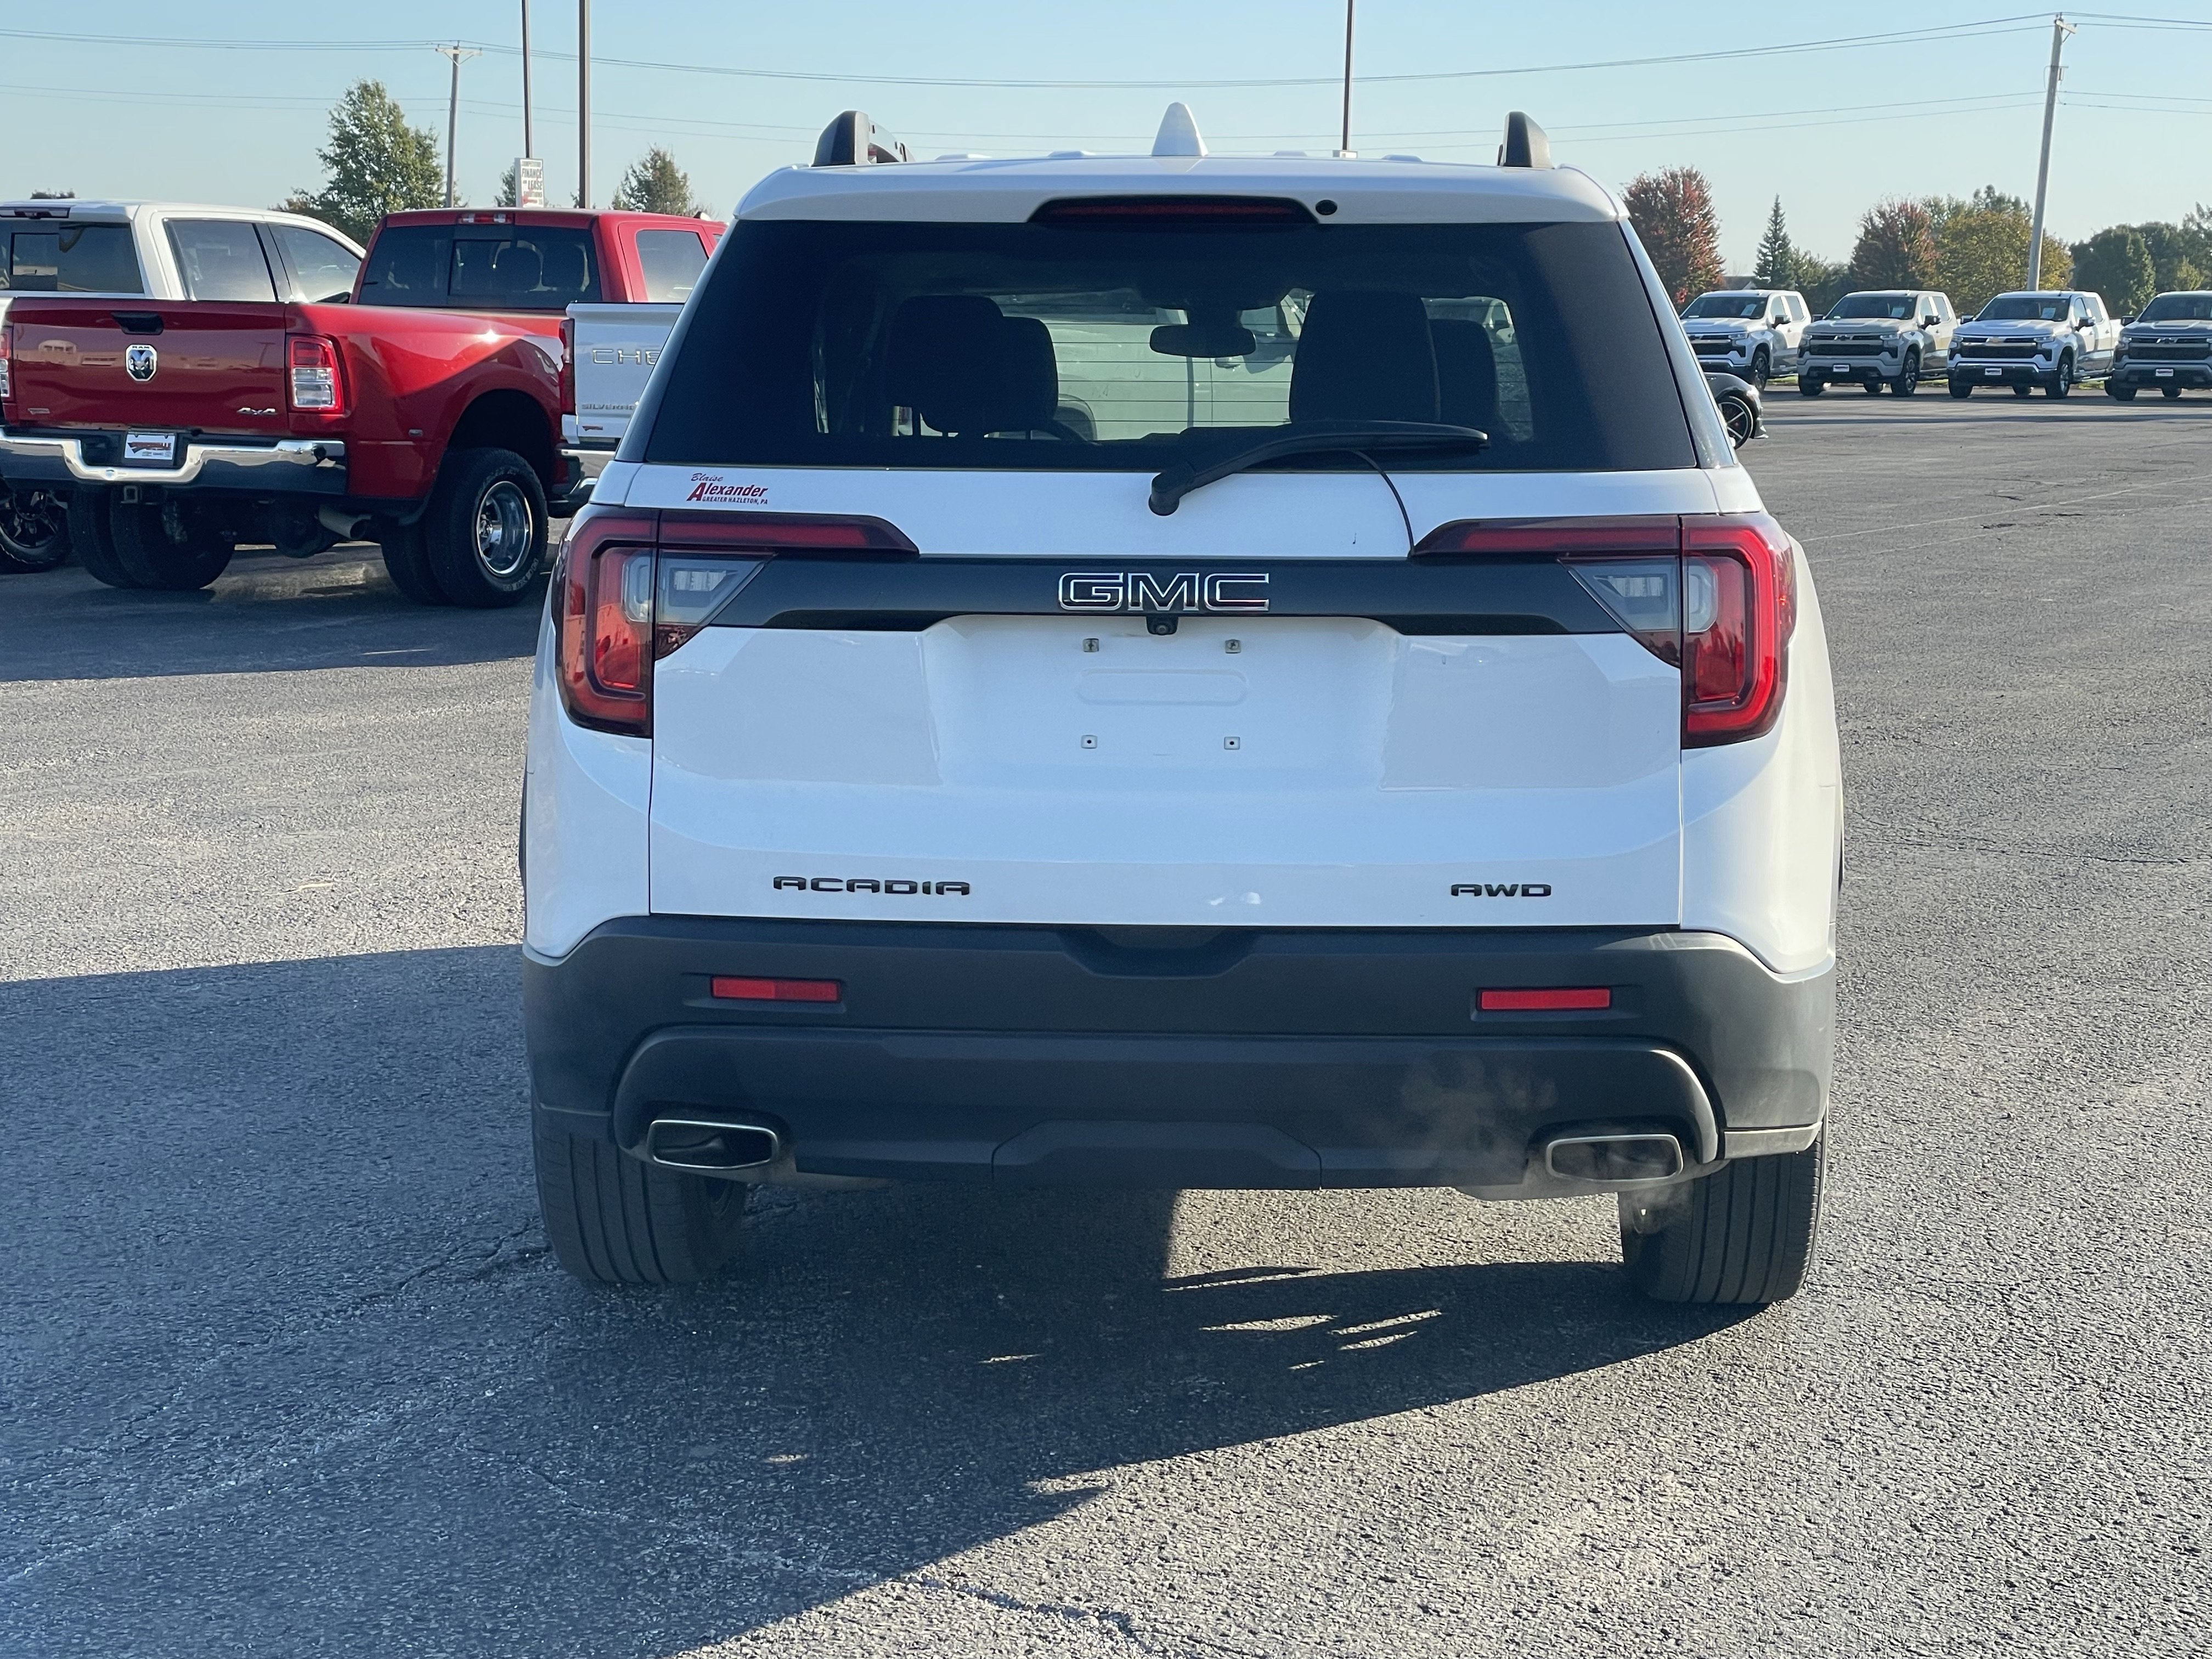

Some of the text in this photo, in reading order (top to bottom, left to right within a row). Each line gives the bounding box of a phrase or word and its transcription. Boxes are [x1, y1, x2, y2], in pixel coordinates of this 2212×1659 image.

[522, 168, 542, 179] FINANCE
[691, 472, 723, 482] Blaise
[686, 482, 768, 501] Alexander
[1058, 572, 1269, 611] GMC
[773, 876, 970, 896] ACADIA
[1451, 884, 1551, 897] AWD
